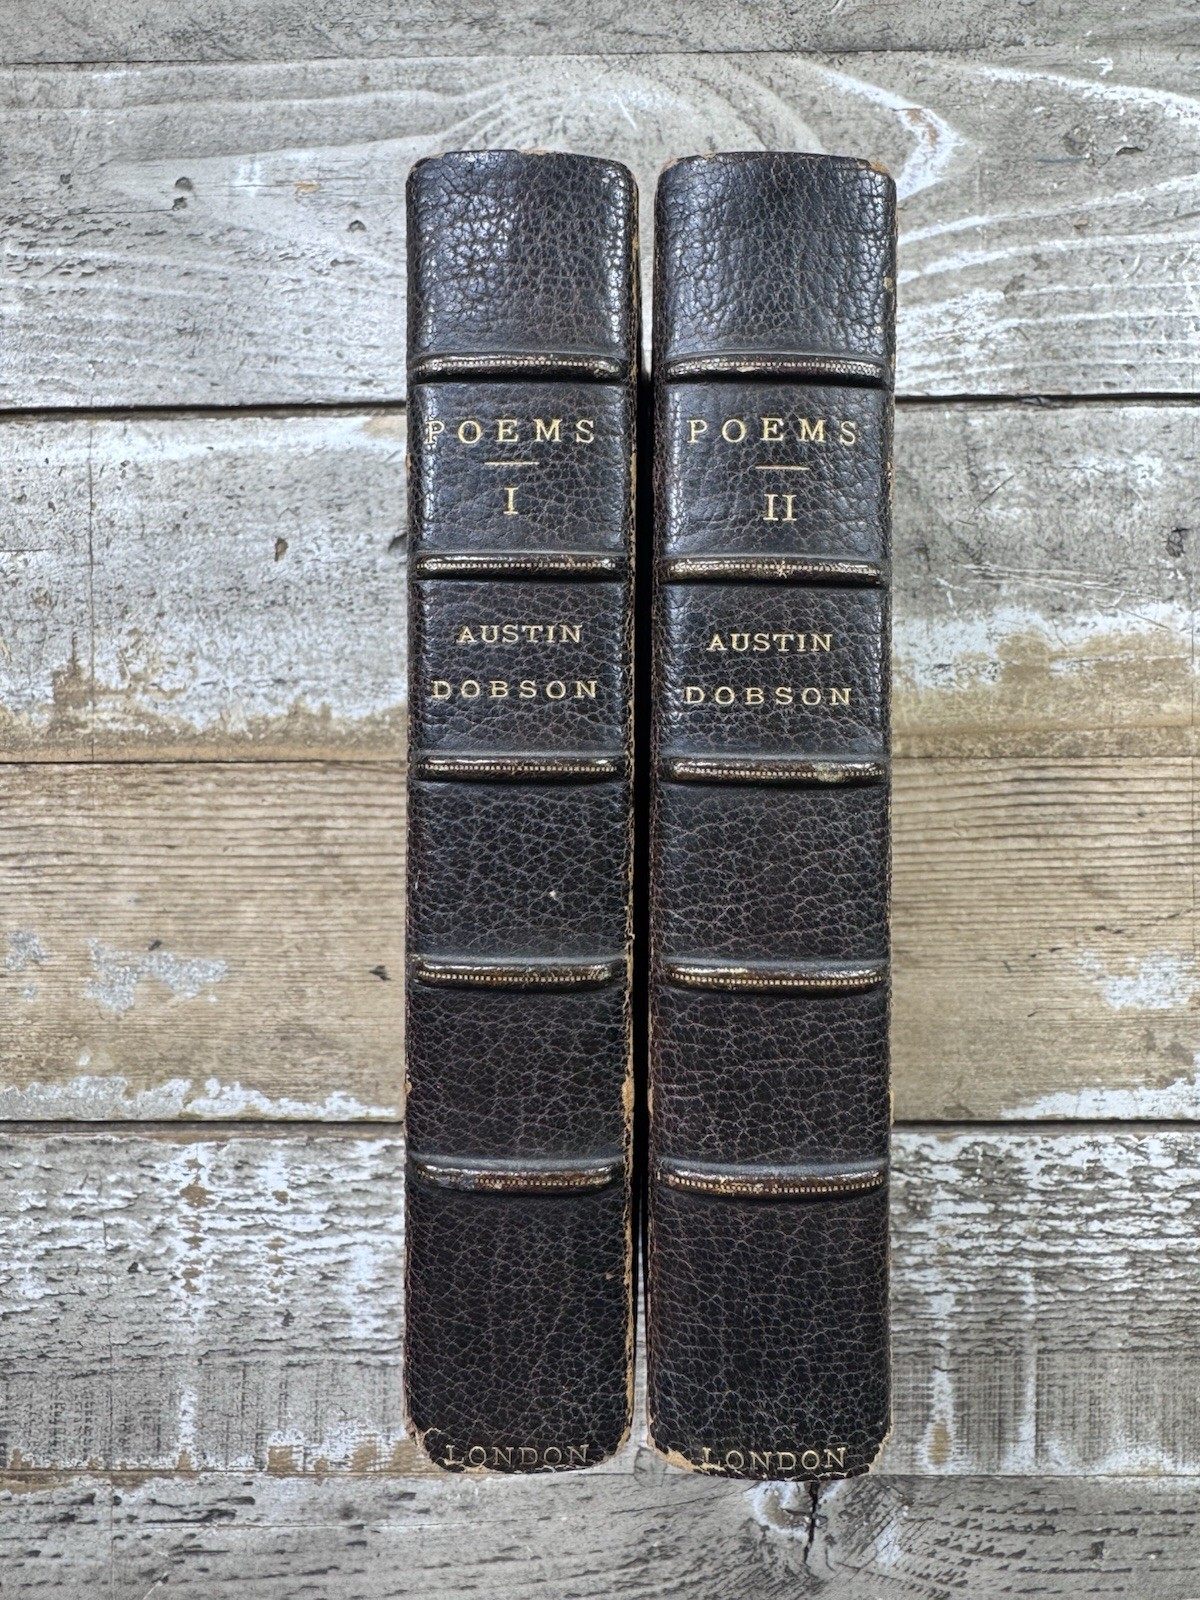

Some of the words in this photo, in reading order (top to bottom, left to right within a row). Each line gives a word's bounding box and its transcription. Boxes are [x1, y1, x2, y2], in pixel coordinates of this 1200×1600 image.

[423, 419, 596, 444] POEMS
[686, 417, 857, 446] POEMS
[503, 487, 519, 515] I
[762, 493, 798, 521] II
[456, 624, 583, 644] AUSTIN
[706, 633, 833, 652] AUSTIN
[431, 679, 598, 699] DOBSON
[684, 686, 852, 706] DOBSON
[445, 1443, 590, 1466] LONDON
[701, 1446, 847, 1471] LONDON
